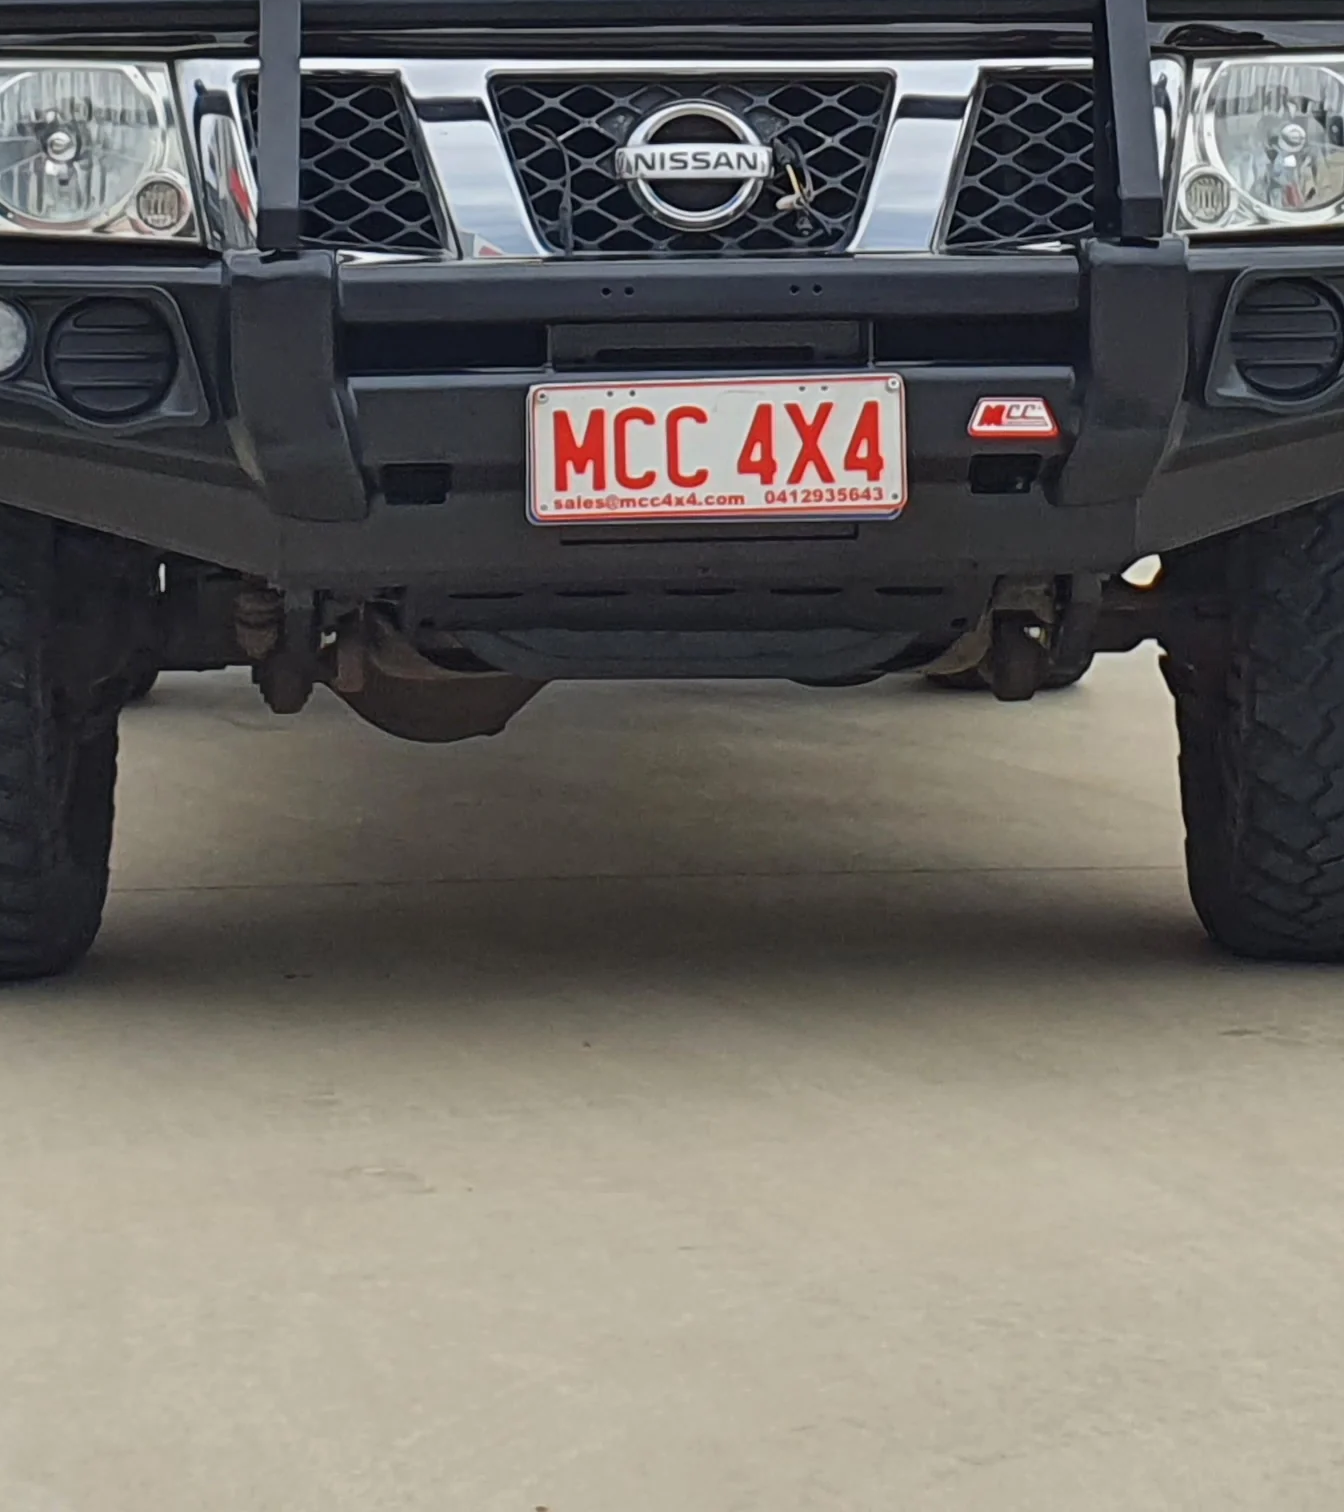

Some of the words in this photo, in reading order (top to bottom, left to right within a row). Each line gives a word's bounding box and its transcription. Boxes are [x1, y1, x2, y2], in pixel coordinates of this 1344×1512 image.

[634, 151, 757, 171] NISSAN
[977, 404, 1048, 426] MCC
[553, 405, 711, 491] MCC
[738, 401, 887, 486] 4X4
[553, 492, 745, 510] sales@mcc4x4.com
[763, 487, 884, 504] 0412935643
